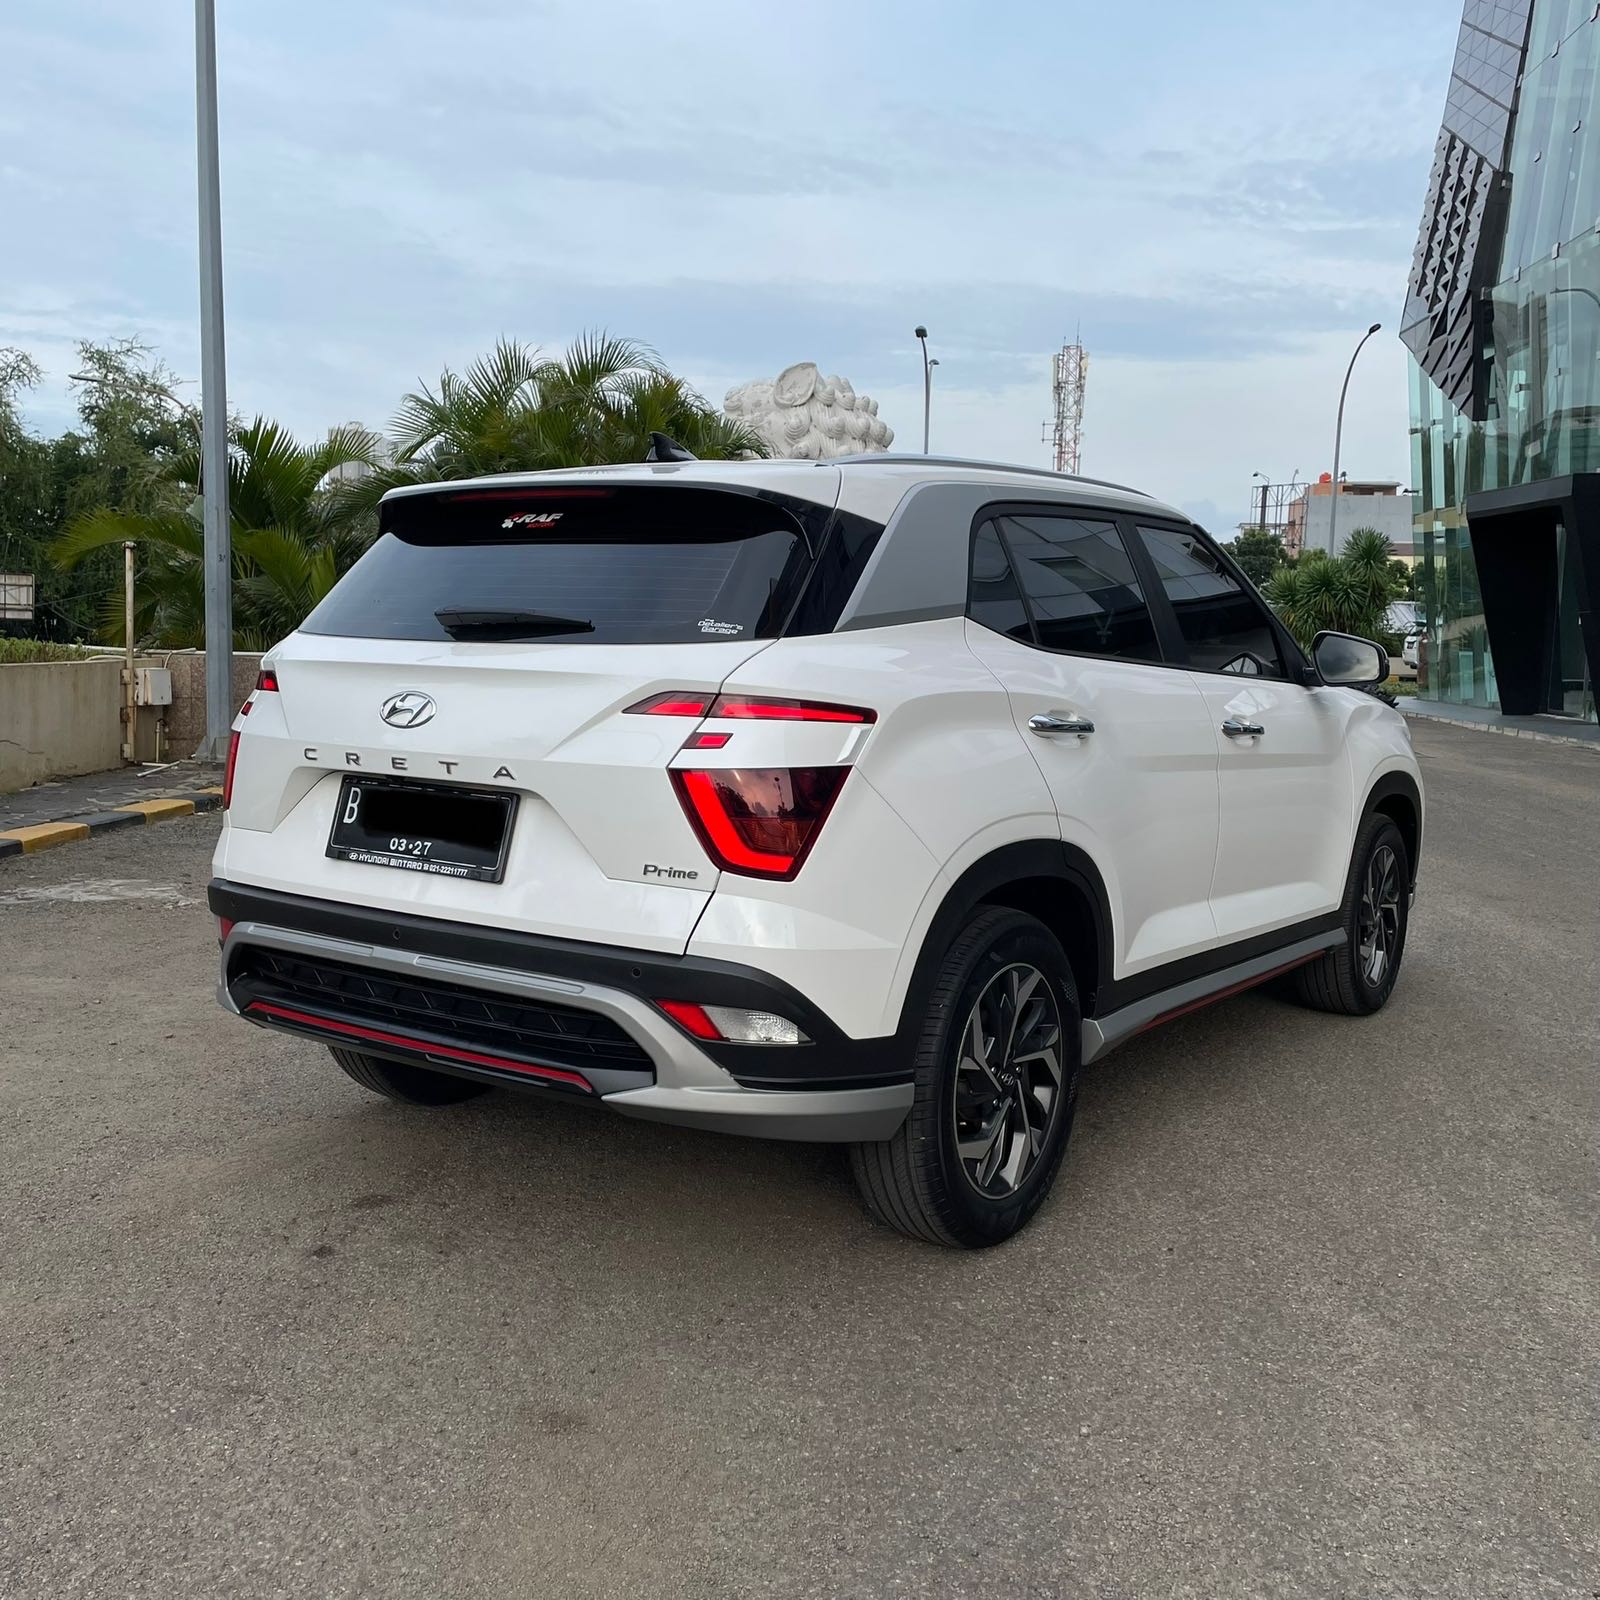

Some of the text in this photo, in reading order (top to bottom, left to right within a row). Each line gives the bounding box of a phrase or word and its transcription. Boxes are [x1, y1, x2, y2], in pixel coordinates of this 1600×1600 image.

[304, 748, 516, 781] CRETA
[343, 786, 362, 824] B
[358, 853, 390, 866] HYUNDAI
[389, 858, 423, 871] BINTARO
[643, 864, 698, 880] Prime
